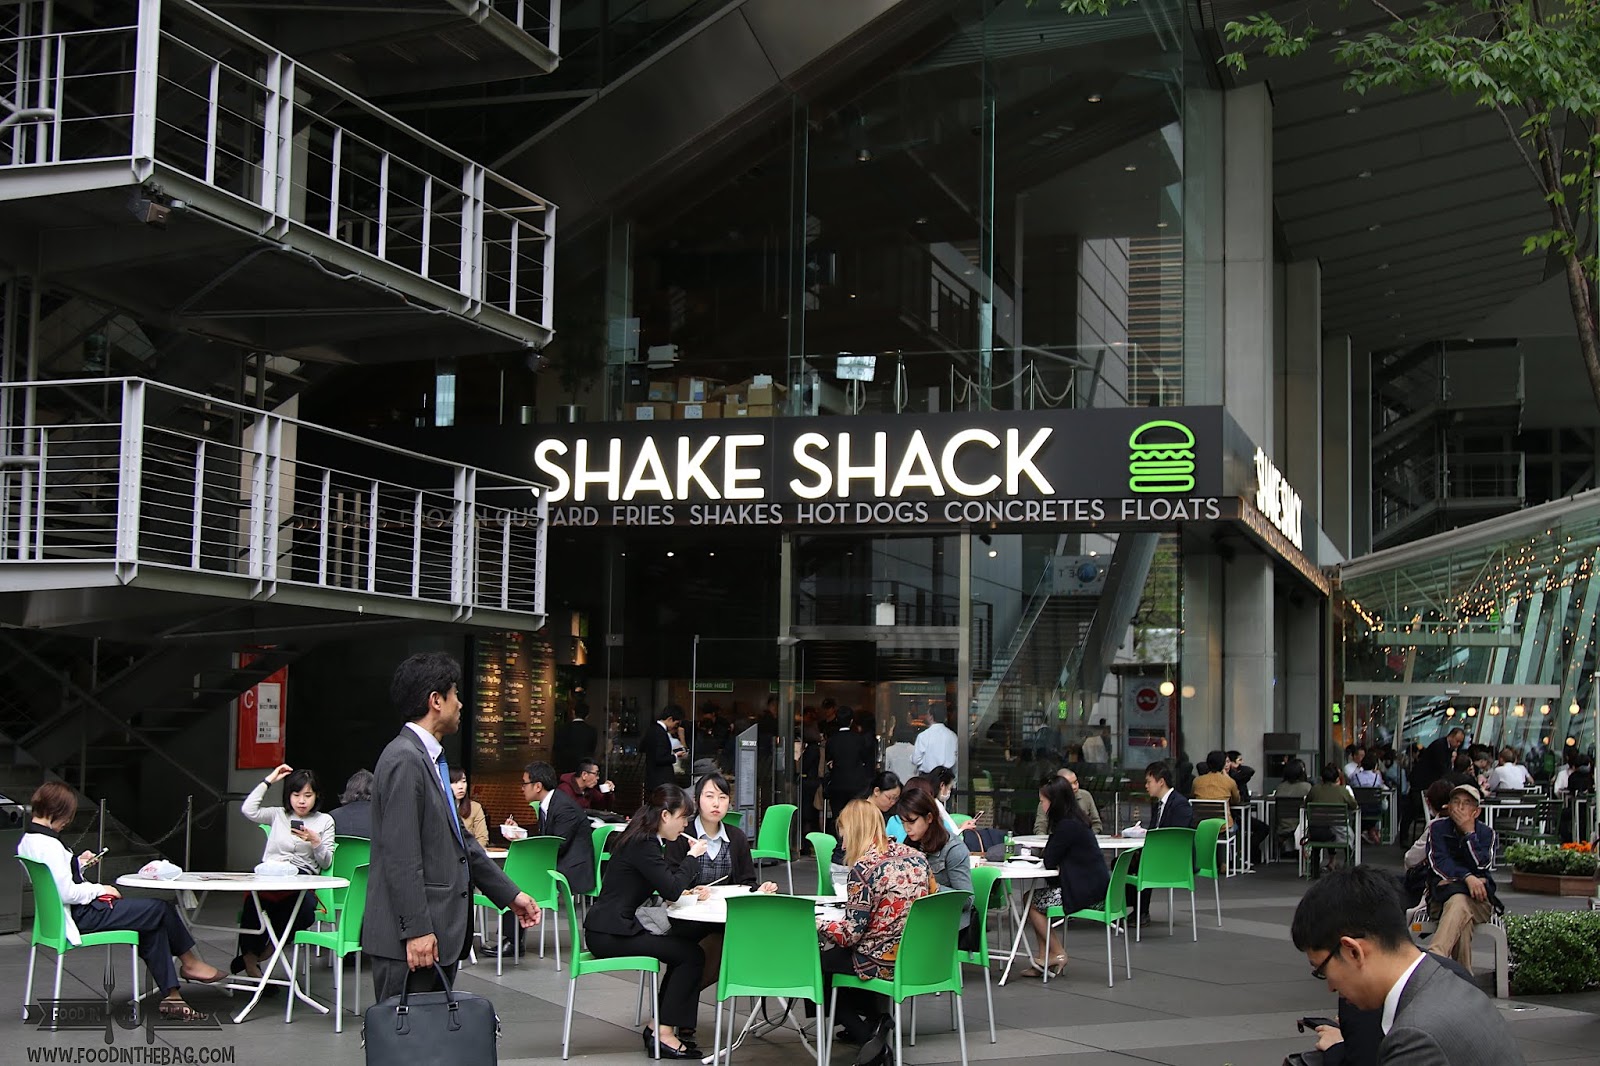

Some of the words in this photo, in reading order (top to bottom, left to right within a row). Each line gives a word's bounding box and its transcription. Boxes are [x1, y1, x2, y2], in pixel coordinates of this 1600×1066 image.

[531, 434, 765, 503] SHAKE
[789, 427, 1056, 499] SHACK
[400, 507, 488, 529] FOZN
[612, 505, 675, 526] FRIES
[689, 503, 783, 525] SHAKES
[797, 502, 850, 524] HOT
[856, 501, 929, 524] DOGS
[944, 499, 1106, 523] CONCRETES
[1121, 498, 1221, 520] FLOATS
[244, 689, 254, 709] C
